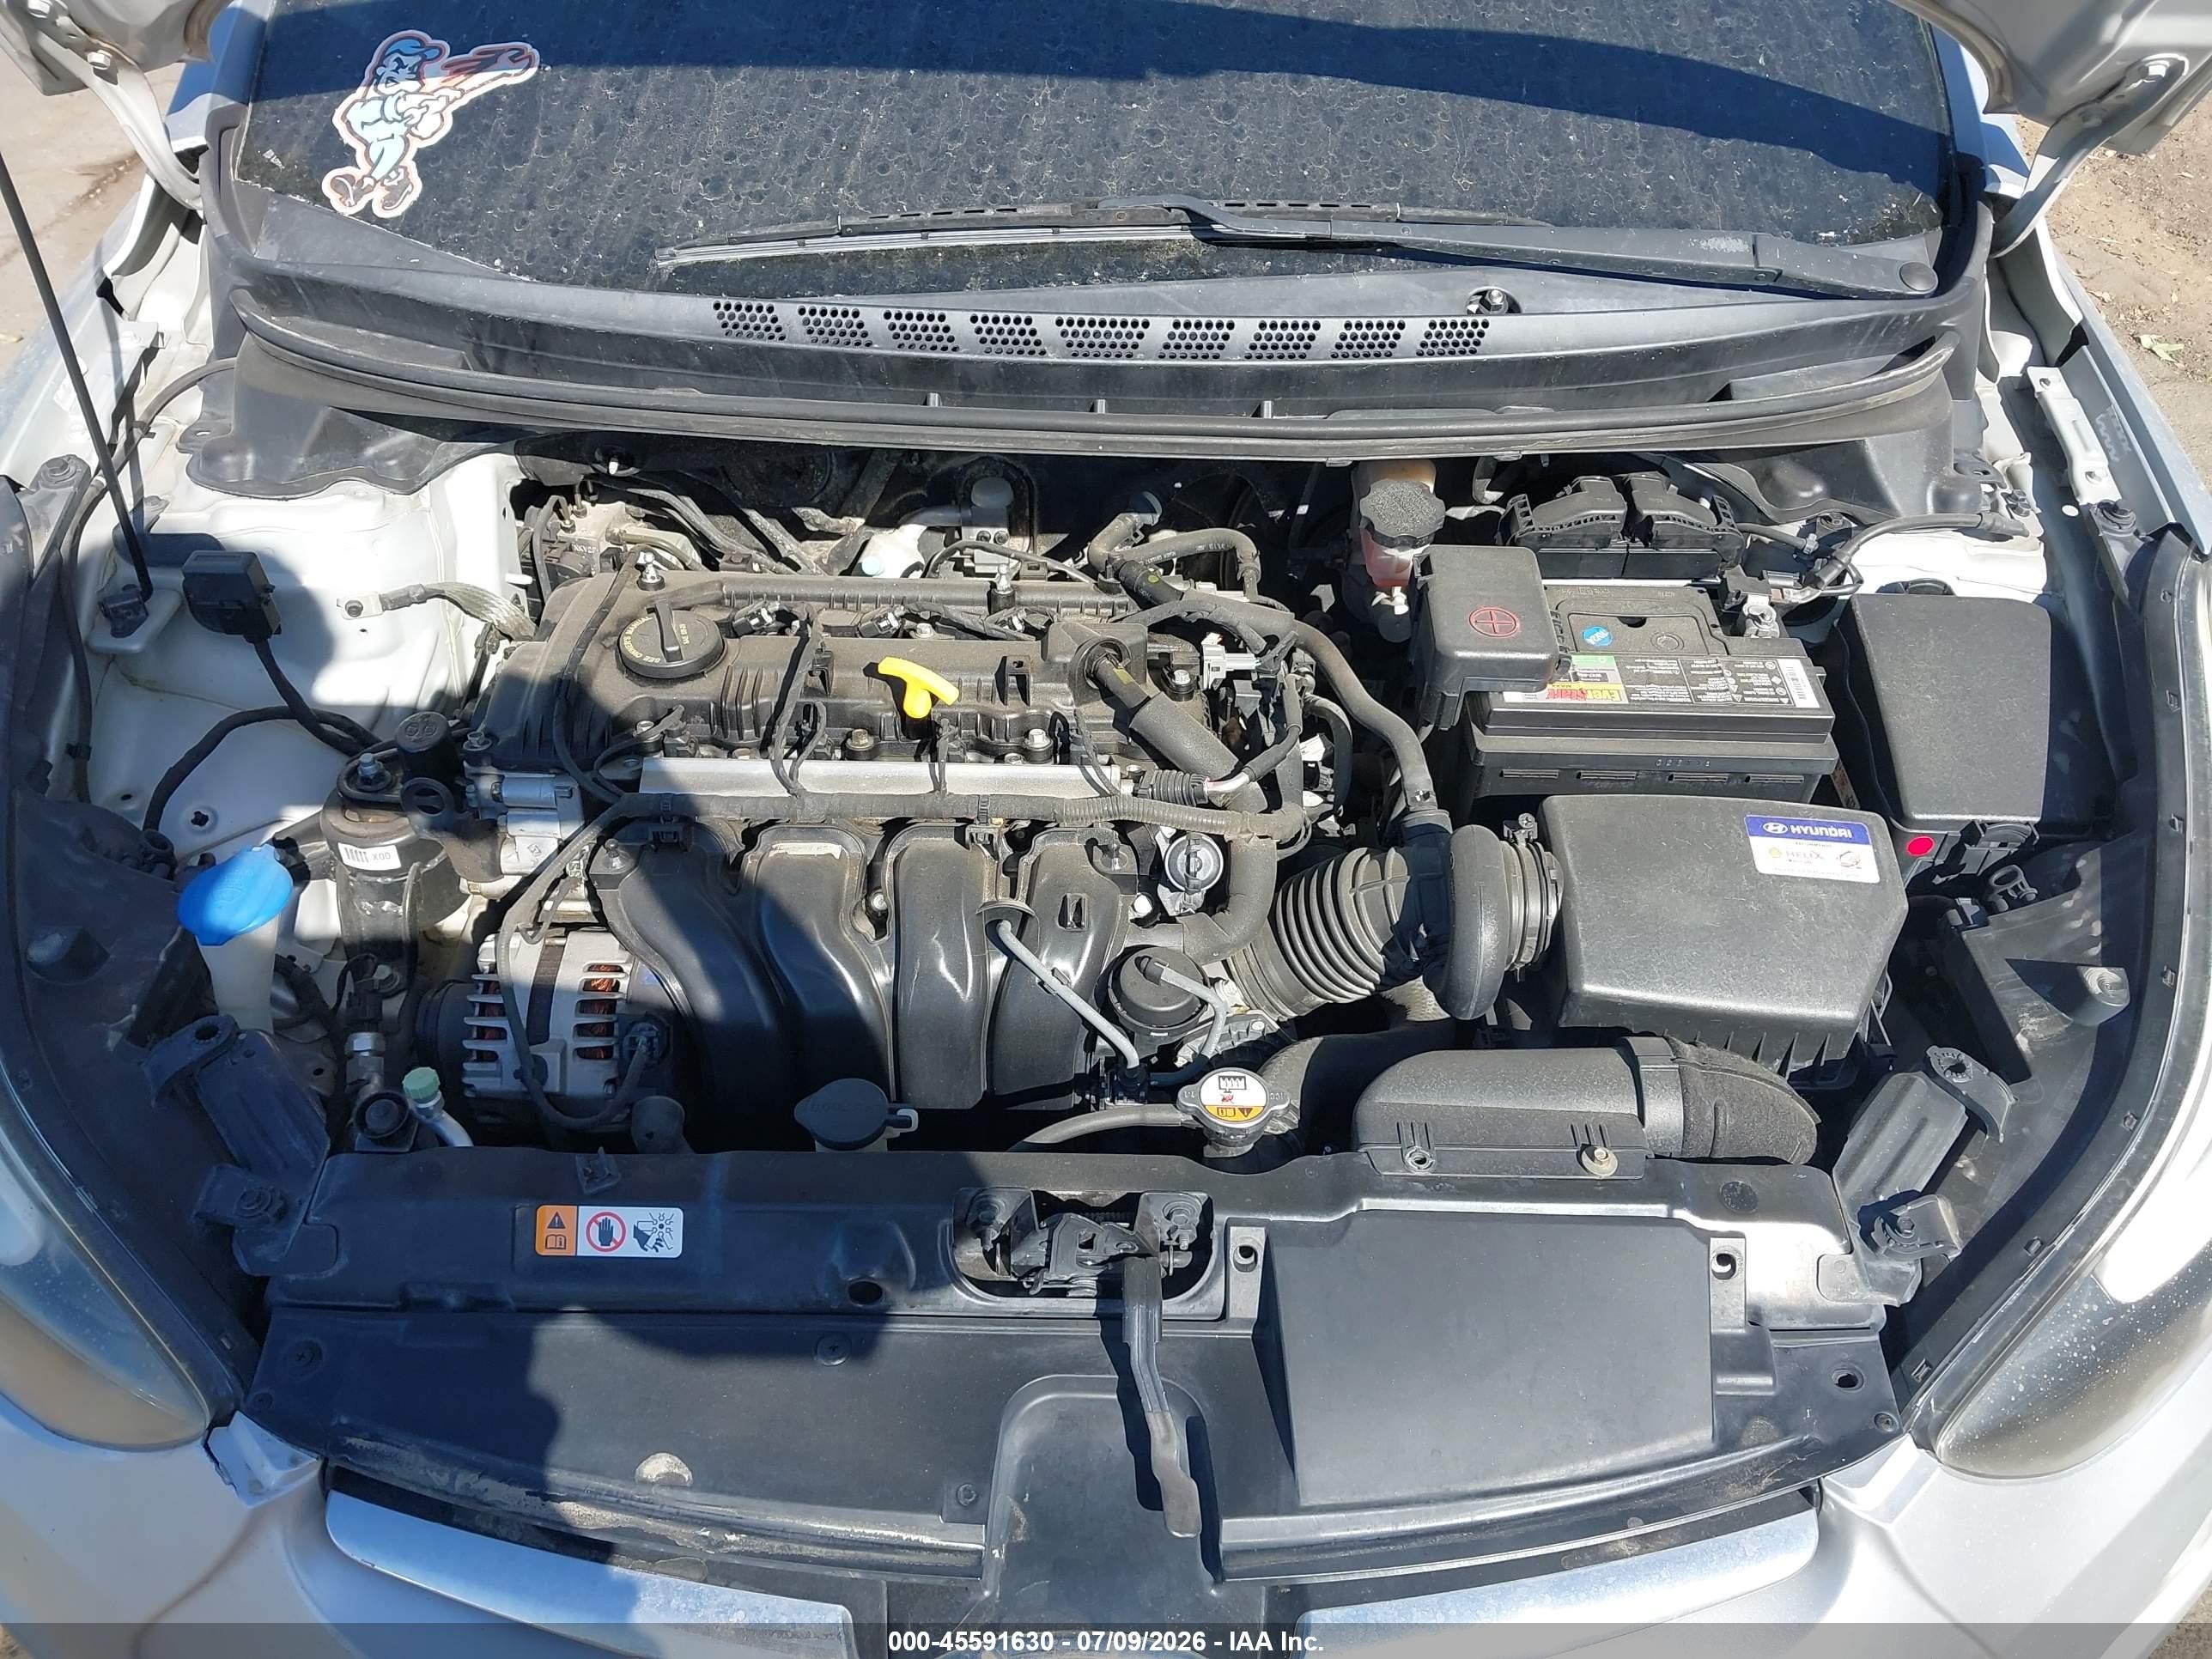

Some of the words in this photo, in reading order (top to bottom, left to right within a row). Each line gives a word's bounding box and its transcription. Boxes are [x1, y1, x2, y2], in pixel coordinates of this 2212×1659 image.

[625, 616, 653, 635] MANUAL
[623, 635, 643, 658] OWNER'S
[1545, 689, 1621, 702] EverStart
[1790, 824, 1853, 839] HYUNDAI
